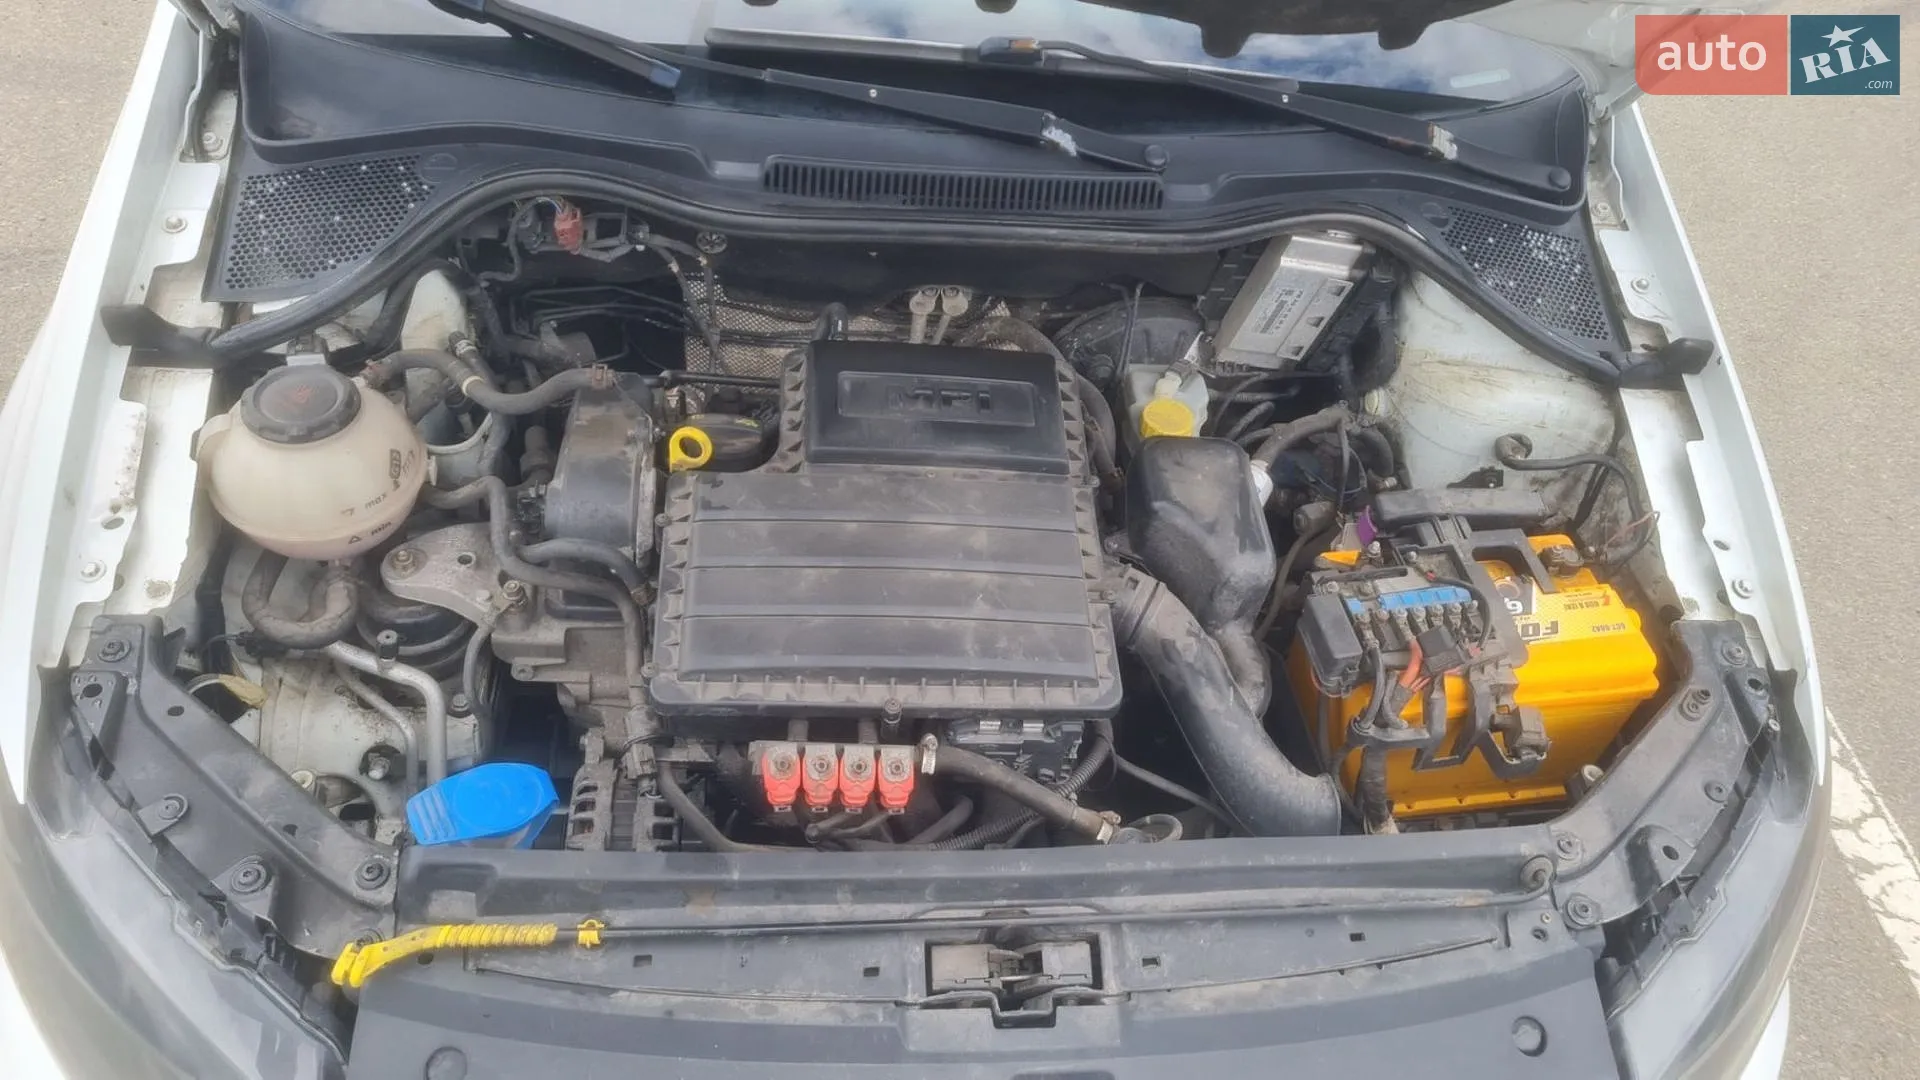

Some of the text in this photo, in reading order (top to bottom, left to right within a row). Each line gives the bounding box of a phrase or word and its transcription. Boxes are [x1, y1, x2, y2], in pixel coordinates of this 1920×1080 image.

[886, 388, 991, 411] MPI
[365, 493, 387, 509] max
[371, 521, 392, 536] min
